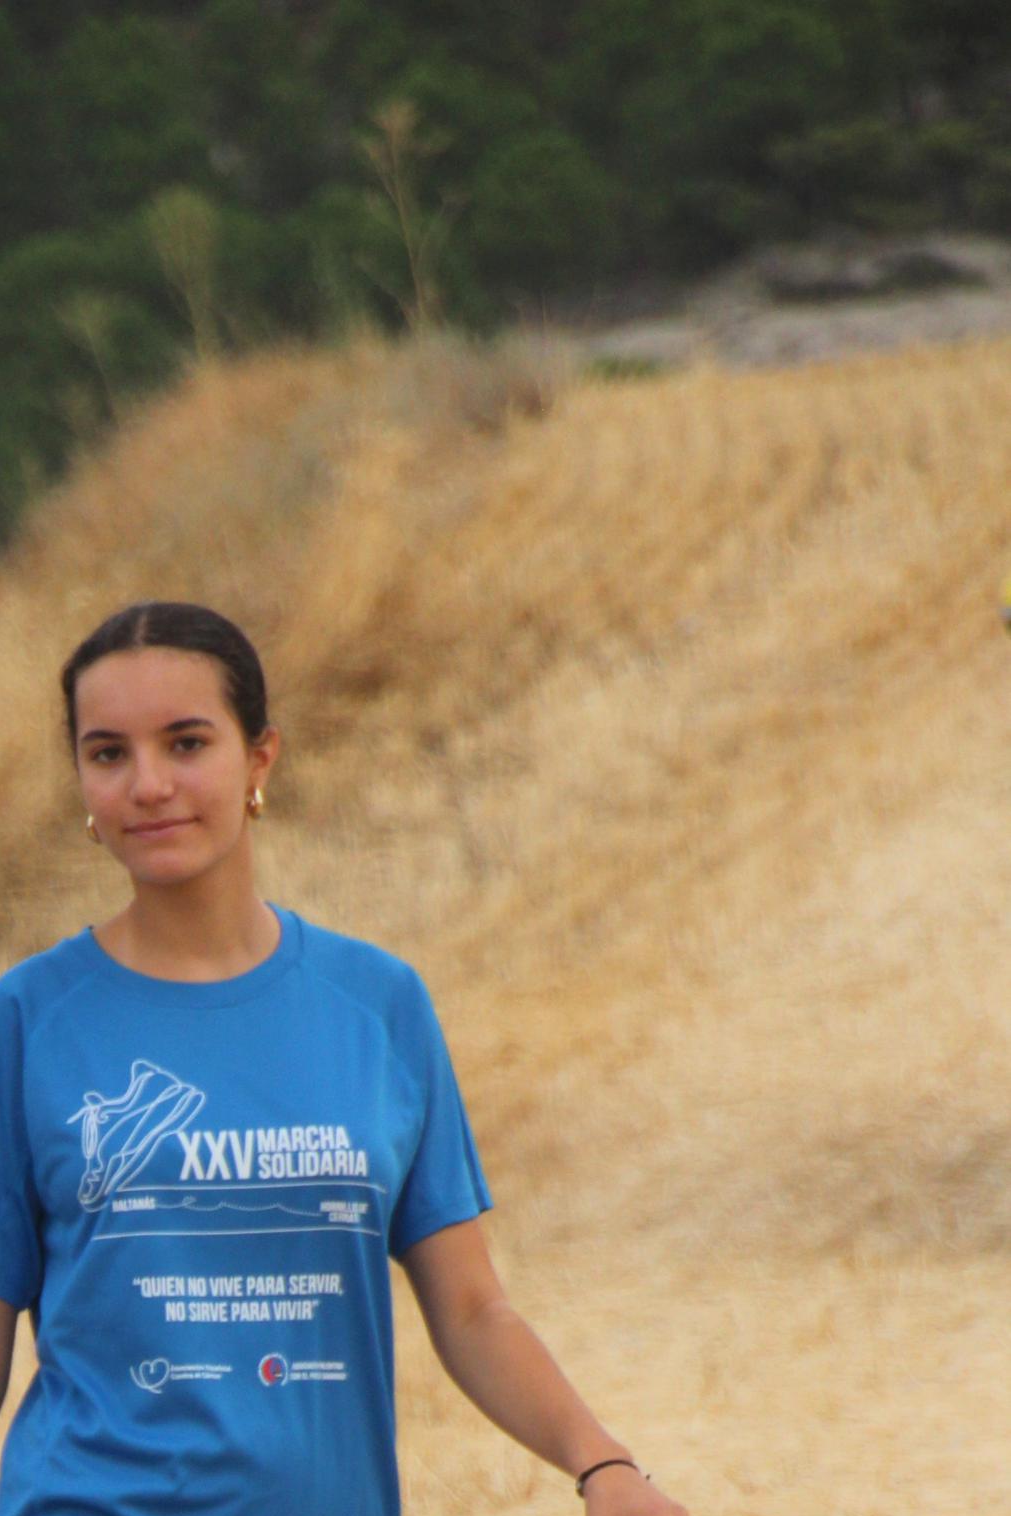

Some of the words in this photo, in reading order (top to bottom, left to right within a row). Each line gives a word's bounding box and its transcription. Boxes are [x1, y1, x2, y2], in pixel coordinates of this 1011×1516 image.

[176, 1130, 254, 1180] XXV
[256, 1126, 350, 1152] MARCHA
[258, 1150, 367, 1179] SOLIDARIA
[132, 1276, 185, 1298] "QUIEN
[188, 1277, 207, 1297] NO
[209, 1276, 243, 1296] VIVE
[246, 1275, 285, 1296] PARA
[290, 1274, 343, 1296] SERVIR,
[165, 1301, 185, 1322] NO
[189, 1301, 228, 1322] SIRVE
[231, 1300, 271, 1321] PARA
[273, 1300, 320, 1320] VIVIR"
